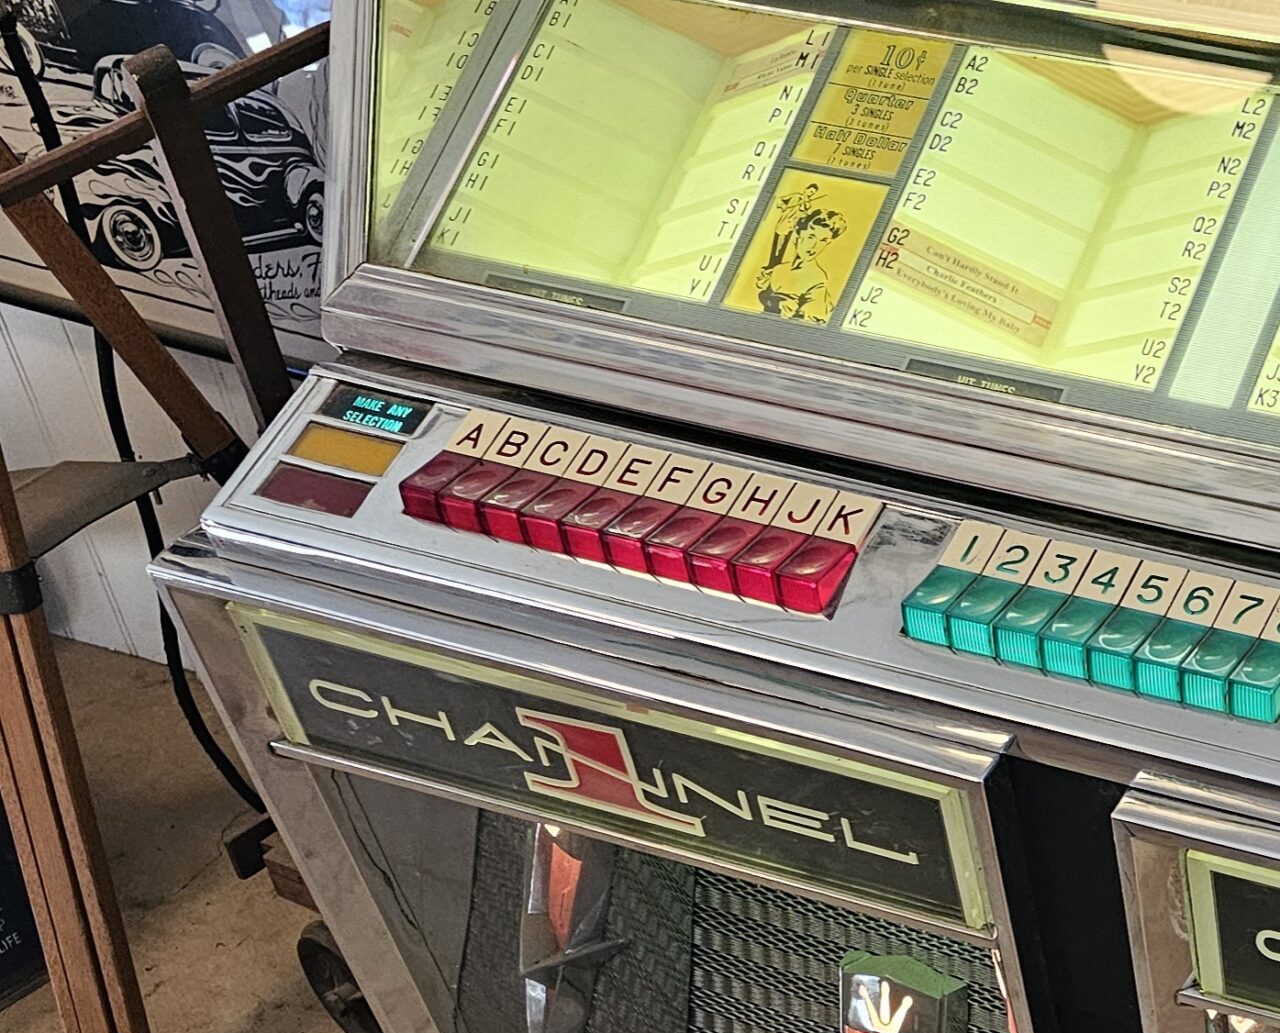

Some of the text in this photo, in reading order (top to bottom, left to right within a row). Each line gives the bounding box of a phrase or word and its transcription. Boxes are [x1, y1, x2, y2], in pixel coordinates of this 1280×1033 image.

[965, 54, 989, 73] A2
[845, 64, 935, 85] per SINGLE selection
[844, 88, 914, 110] Quarter
[851, 104, 894, 121] 3 SINGLES
[814, 126, 908, 152] Half Dollar
[1232, 121, 1256, 140] M2
[833, 143, 876, 160] 7 SINGLES
[887, 227, 910, 246] G2
[848, 309, 872, 328] K2
[352, 396, 413, 418] MAKE ANY
[1255, 388, 1280, 408] K3
[343, 410, 403, 432] SELECTION
[456, 423, 865, 535] A B C D E F G H J K
[960, 535, 979, 563] 1
[996, 546, 1029, 573] 2
[1044, 554, 1078, 584] 3
[1090, 566, 1120, 594] 4
[1137, 575, 1169, 603] 5
[1183, 586, 1214, 615] 6
[1232, 594, 1264, 625] 7
